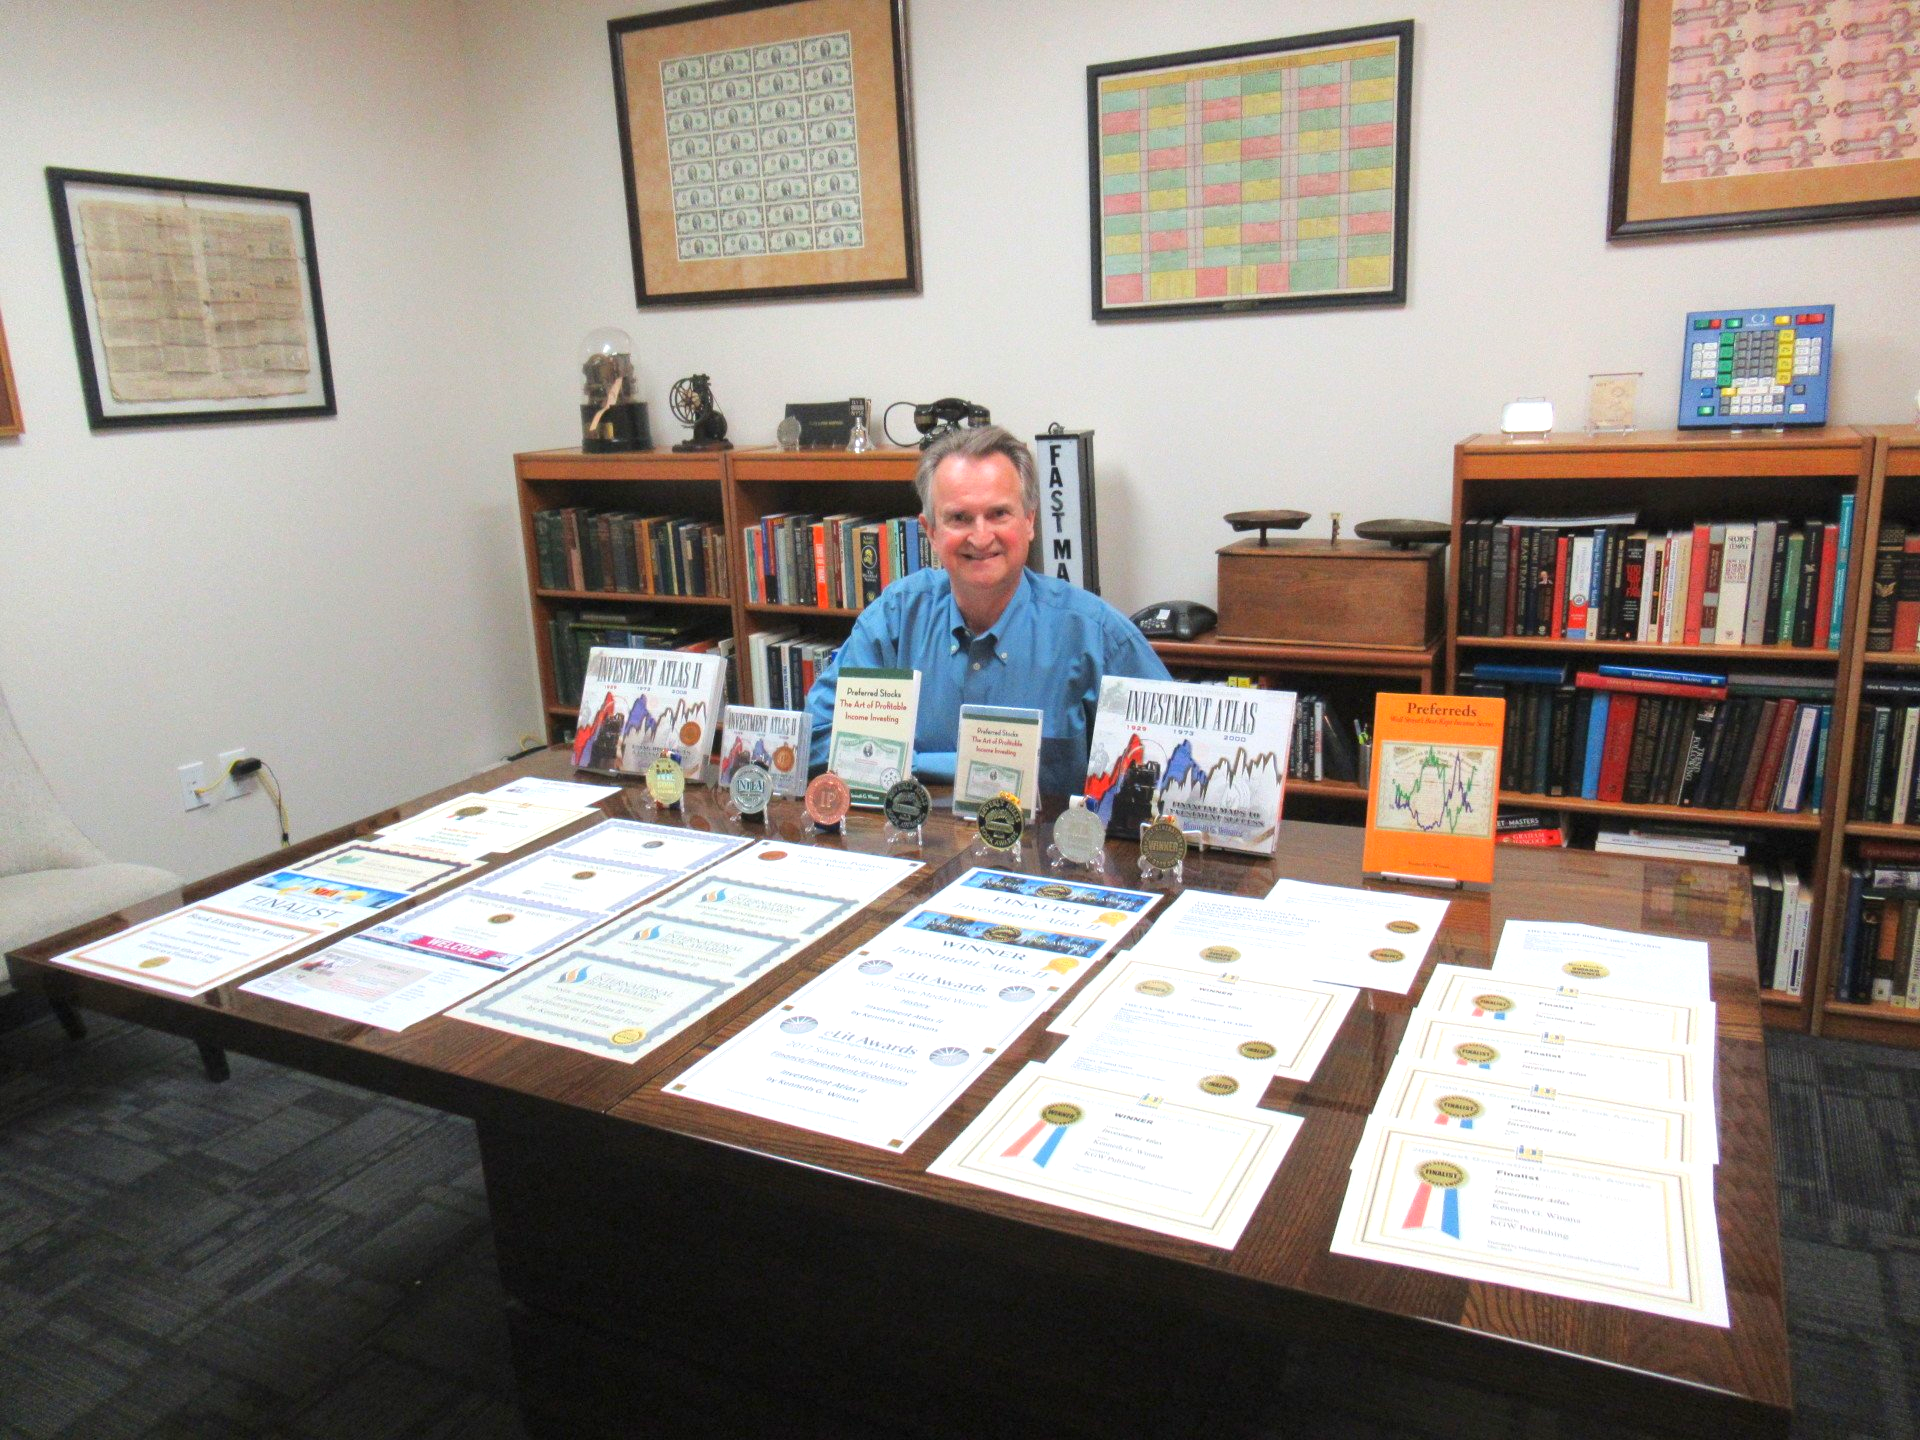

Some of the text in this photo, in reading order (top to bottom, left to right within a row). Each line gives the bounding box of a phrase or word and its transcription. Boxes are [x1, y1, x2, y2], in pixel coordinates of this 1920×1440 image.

[1050, 445, 1065, 533] FAST
[597, 656, 703, 690] INVESTMENT ATLAS II
[847, 688, 902, 698] Preferred Stocks
[840, 699, 852, 707] The
[854, 700, 865, 708] Art
[875, 701, 907, 710] Profitable
[1408, 702, 1478, 717] Preferreds
[845, 712, 899, 725] Income Investing
[1126, 690, 1258, 736] INVESTMENT ATLAS
[728, 712, 768, 732] INVESTMENT
[770, 716, 790, 735] ATLAS
[977, 728, 1019, 738] Preferred Stocks
[1126, 724, 1147, 732] 1929
[1224, 734, 1246, 742] 2000
[998, 738, 1022, 748] Profitable
[976, 746, 1016, 757] Income Investing
[1509, 817, 1539, 826] MASTERS
[1513, 831, 1545, 840] GRAHAM
[245, 895, 344, 920] FINALIST
[954, 902, 1036, 921] Investment
[993, 896, 1085, 916] FINALIST
[428, 937, 485, 956] WELCOME
[943, 940, 1026, 960] WINNER
[892, 946, 980, 968] Investment
[930, 977, 988, 994] Awards
[1198, 987, 1234, 996] WINNER
[1538, 1001, 1574, 1010] Finalist
[824, 1030, 855, 1042] eLit
[856, 1036, 918, 1056] Awards
[1462, 1048, 1491, 1058] FINALIST
[1524, 1049, 1562, 1060] Finalist
[766, 1076, 777, 1084] by
[780, 1070, 833, 1086] Investment
[832, 1082, 856, 1092] Atlas
[1443, 1102, 1475, 1112] FINALIST
[1510, 1104, 1552, 1116] Finalist
[1048, 1110, 1075, 1119] WINNER
[1114, 1112, 1155, 1126] WINNER
[1107, 1156, 1146, 1170] Publishing
[1424, 1168, 1459, 1180] FINALIST
[1496, 1170, 1541, 1182] Finalist
[1494, 1189, 1545, 1202] Investment
[1546, 1197, 1571, 1206] Atlas
[1492, 1202, 1531, 1216] Kenneth
[1546, 1212, 1582, 1224] Winans
[1490, 1219, 1518, 1230] KGW
[1520, 1223, 1570, 1240] Publishing
